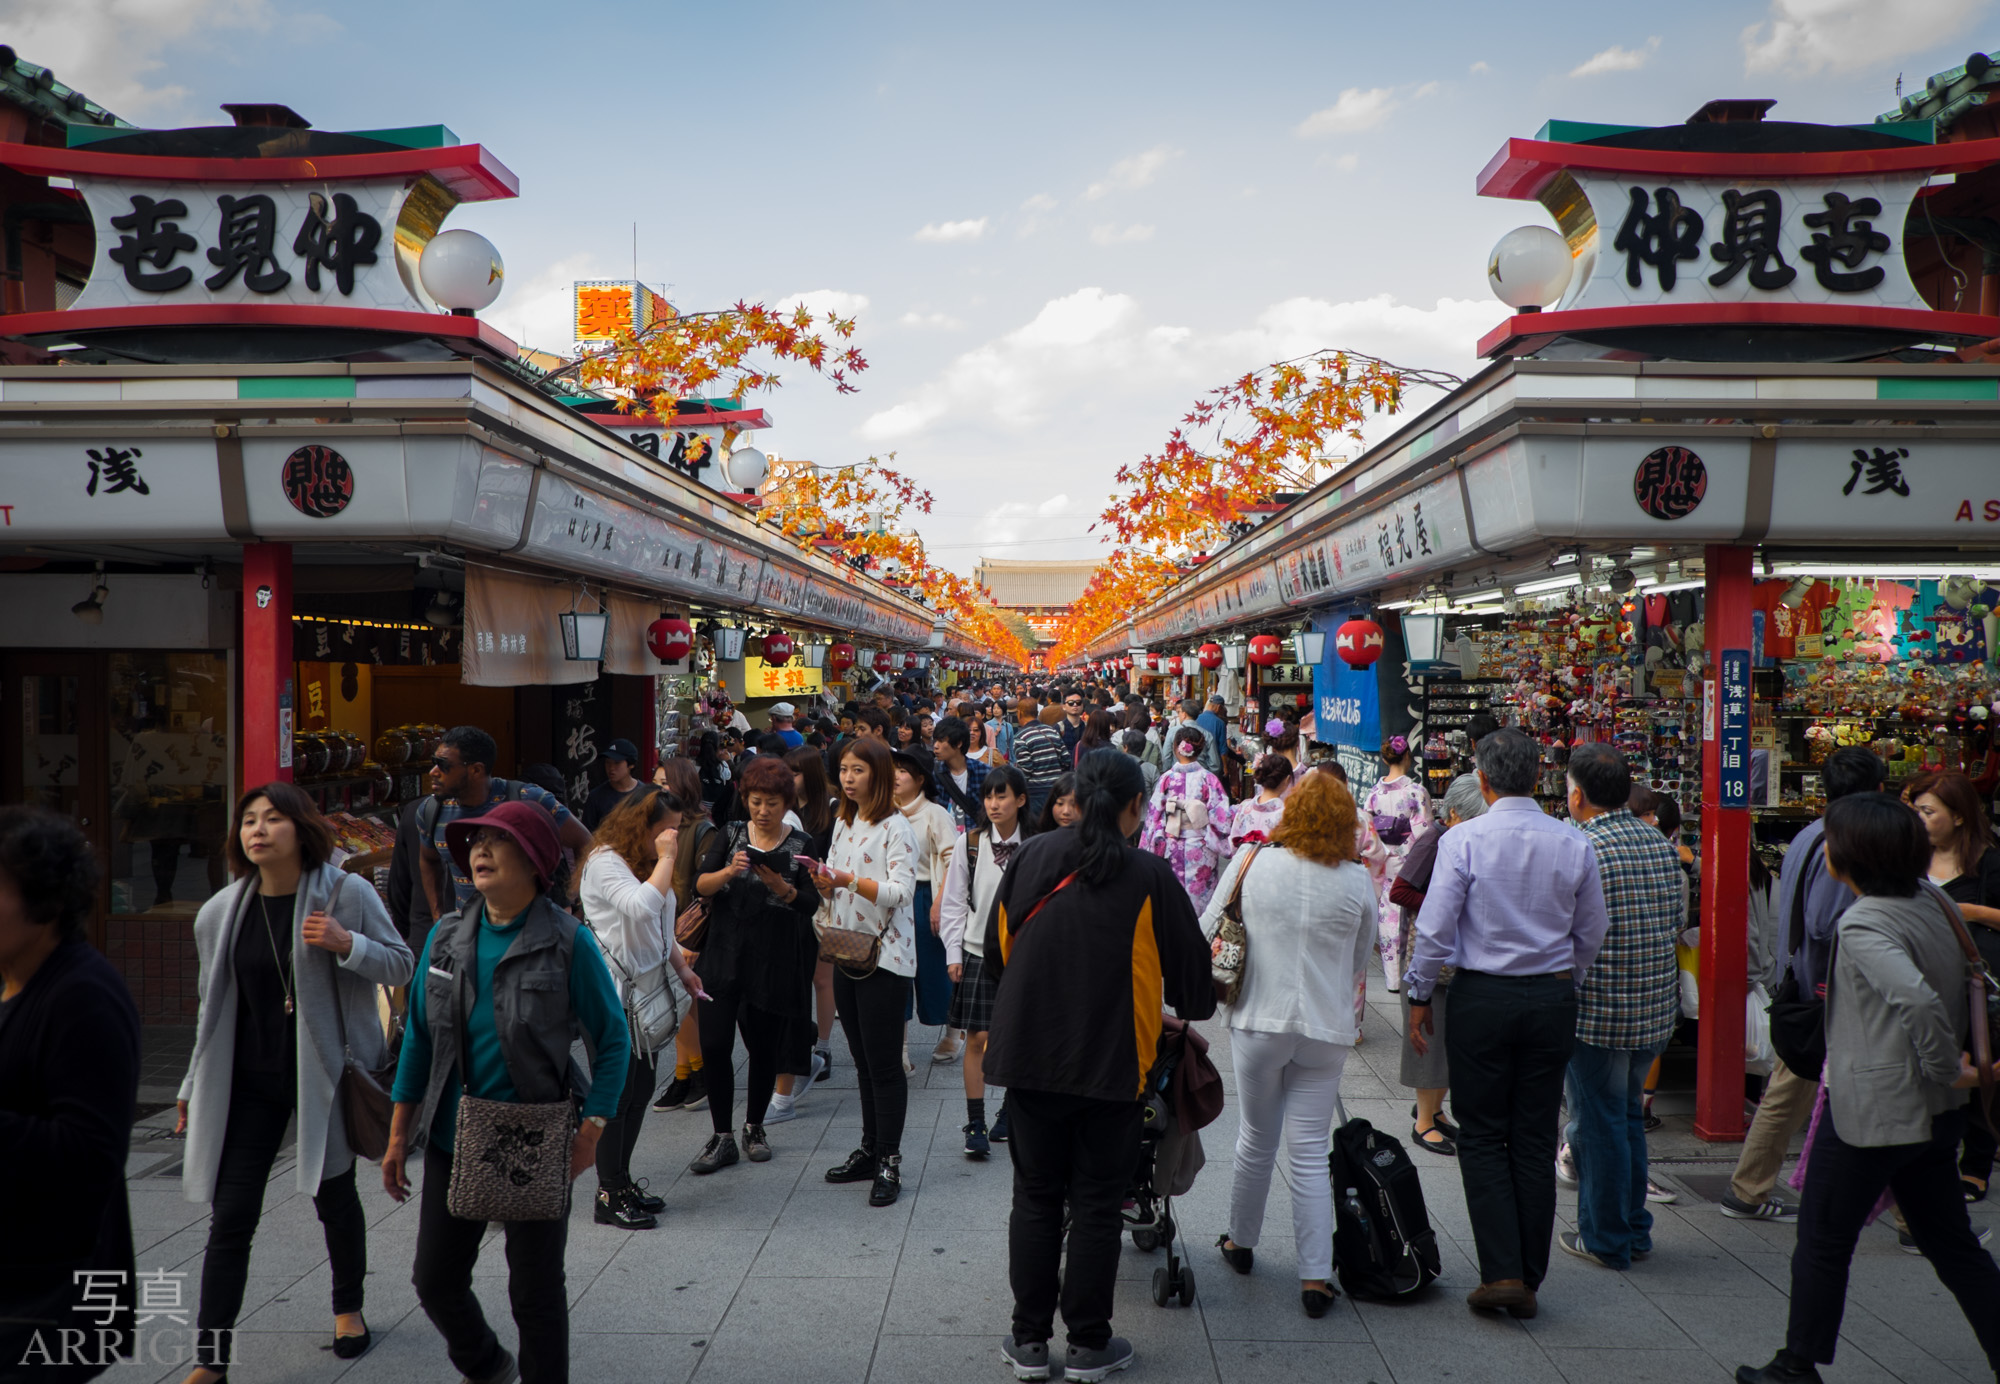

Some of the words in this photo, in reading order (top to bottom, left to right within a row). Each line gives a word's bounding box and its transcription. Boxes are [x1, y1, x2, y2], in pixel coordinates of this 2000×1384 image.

[1613, 186, 1891, 293] 仲見世
[579, 289, 631, 335] 薬
[86, 447, 150, 497] 浅
[1843, 447, 1910, 497] 浅
[1376, 501, 1434, 570] 福光屋
[307, 680, 325, 719] 豆
[763, 669, 807, 691] 半額
[787, 685, 818, 694] サービス
[1728, 685, 1742, 768] 浅草一丁目
[1724, 780, 1744, 798] 18
